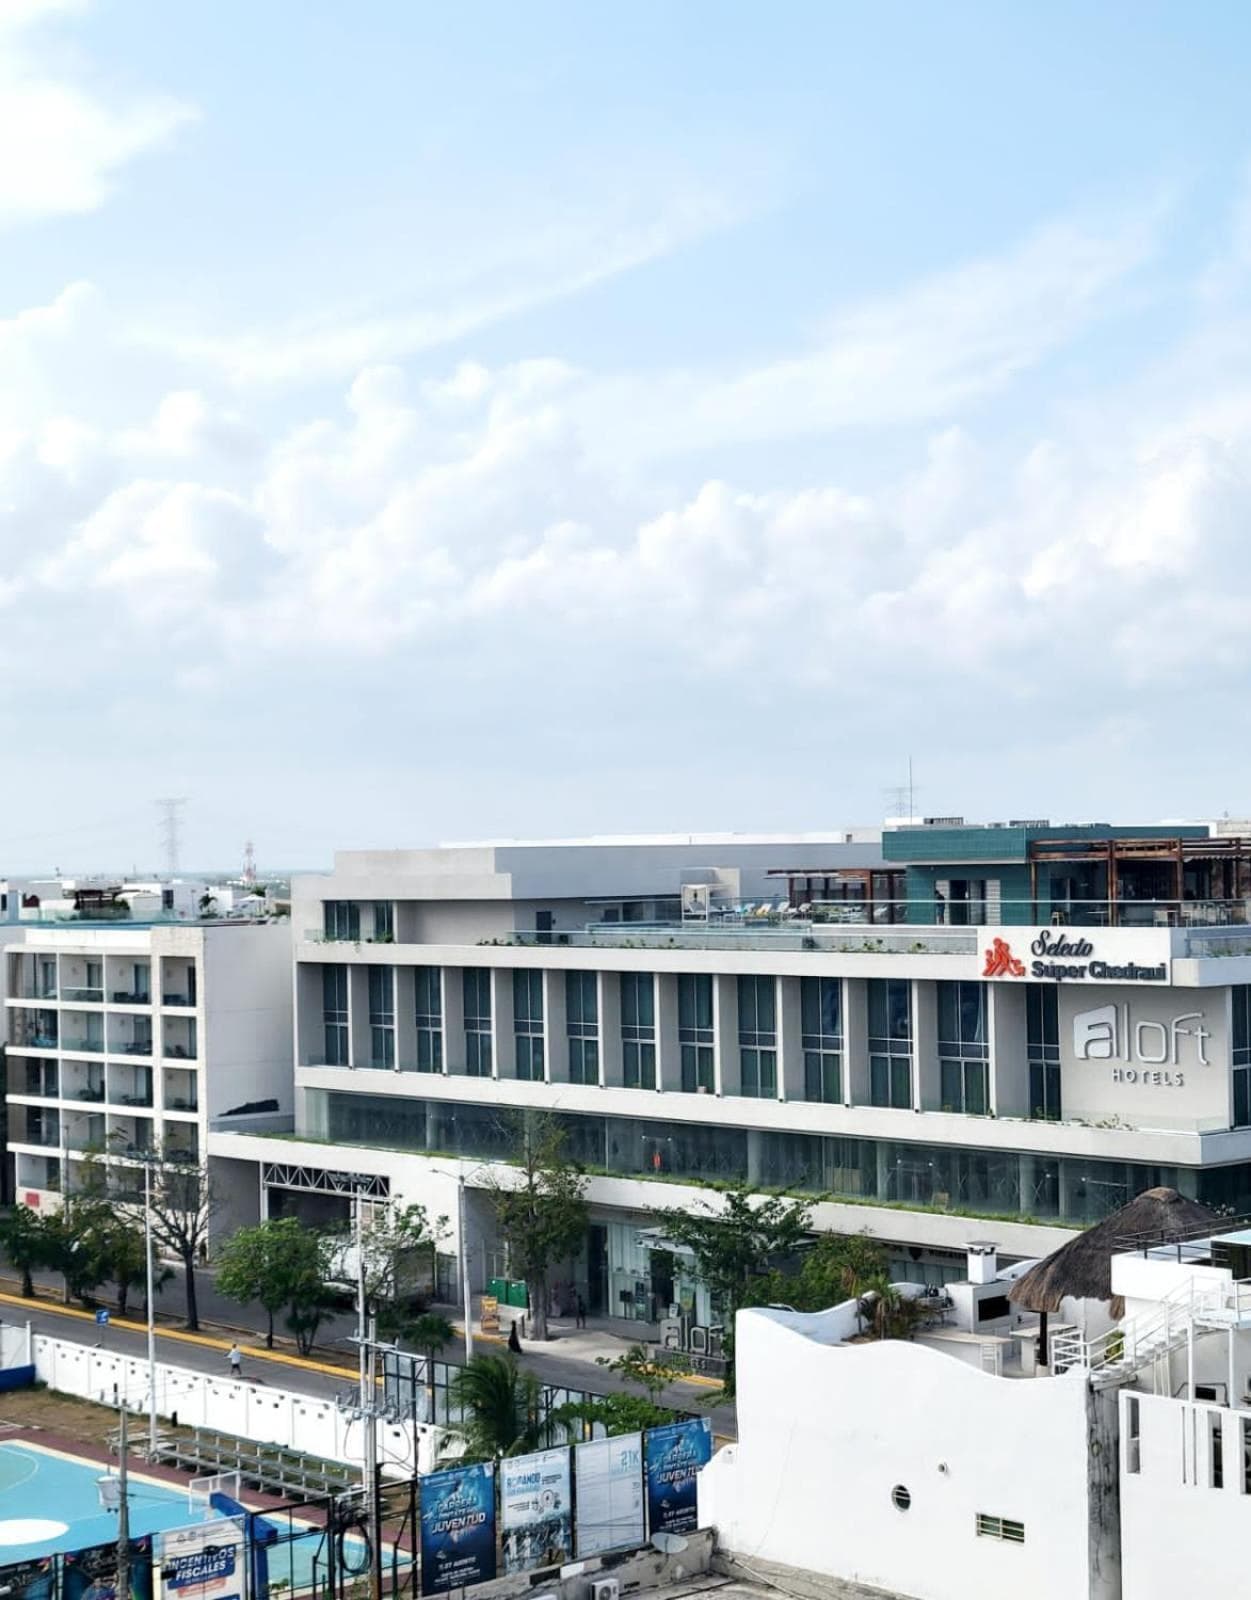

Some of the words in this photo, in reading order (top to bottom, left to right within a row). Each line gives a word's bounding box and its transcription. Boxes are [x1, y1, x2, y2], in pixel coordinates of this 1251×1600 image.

[1031, 930, 1093, 957] Selecto
[1088, 961, 1166, 980] Chedraui
[1073, 1003, 1211, 1066] aloft
[1112, 1069, 1184, 1086] HOTELS
[432, 1512, 486, 1535] JUVENTUD
[176, 1561, 226, 1581] FISCALES
